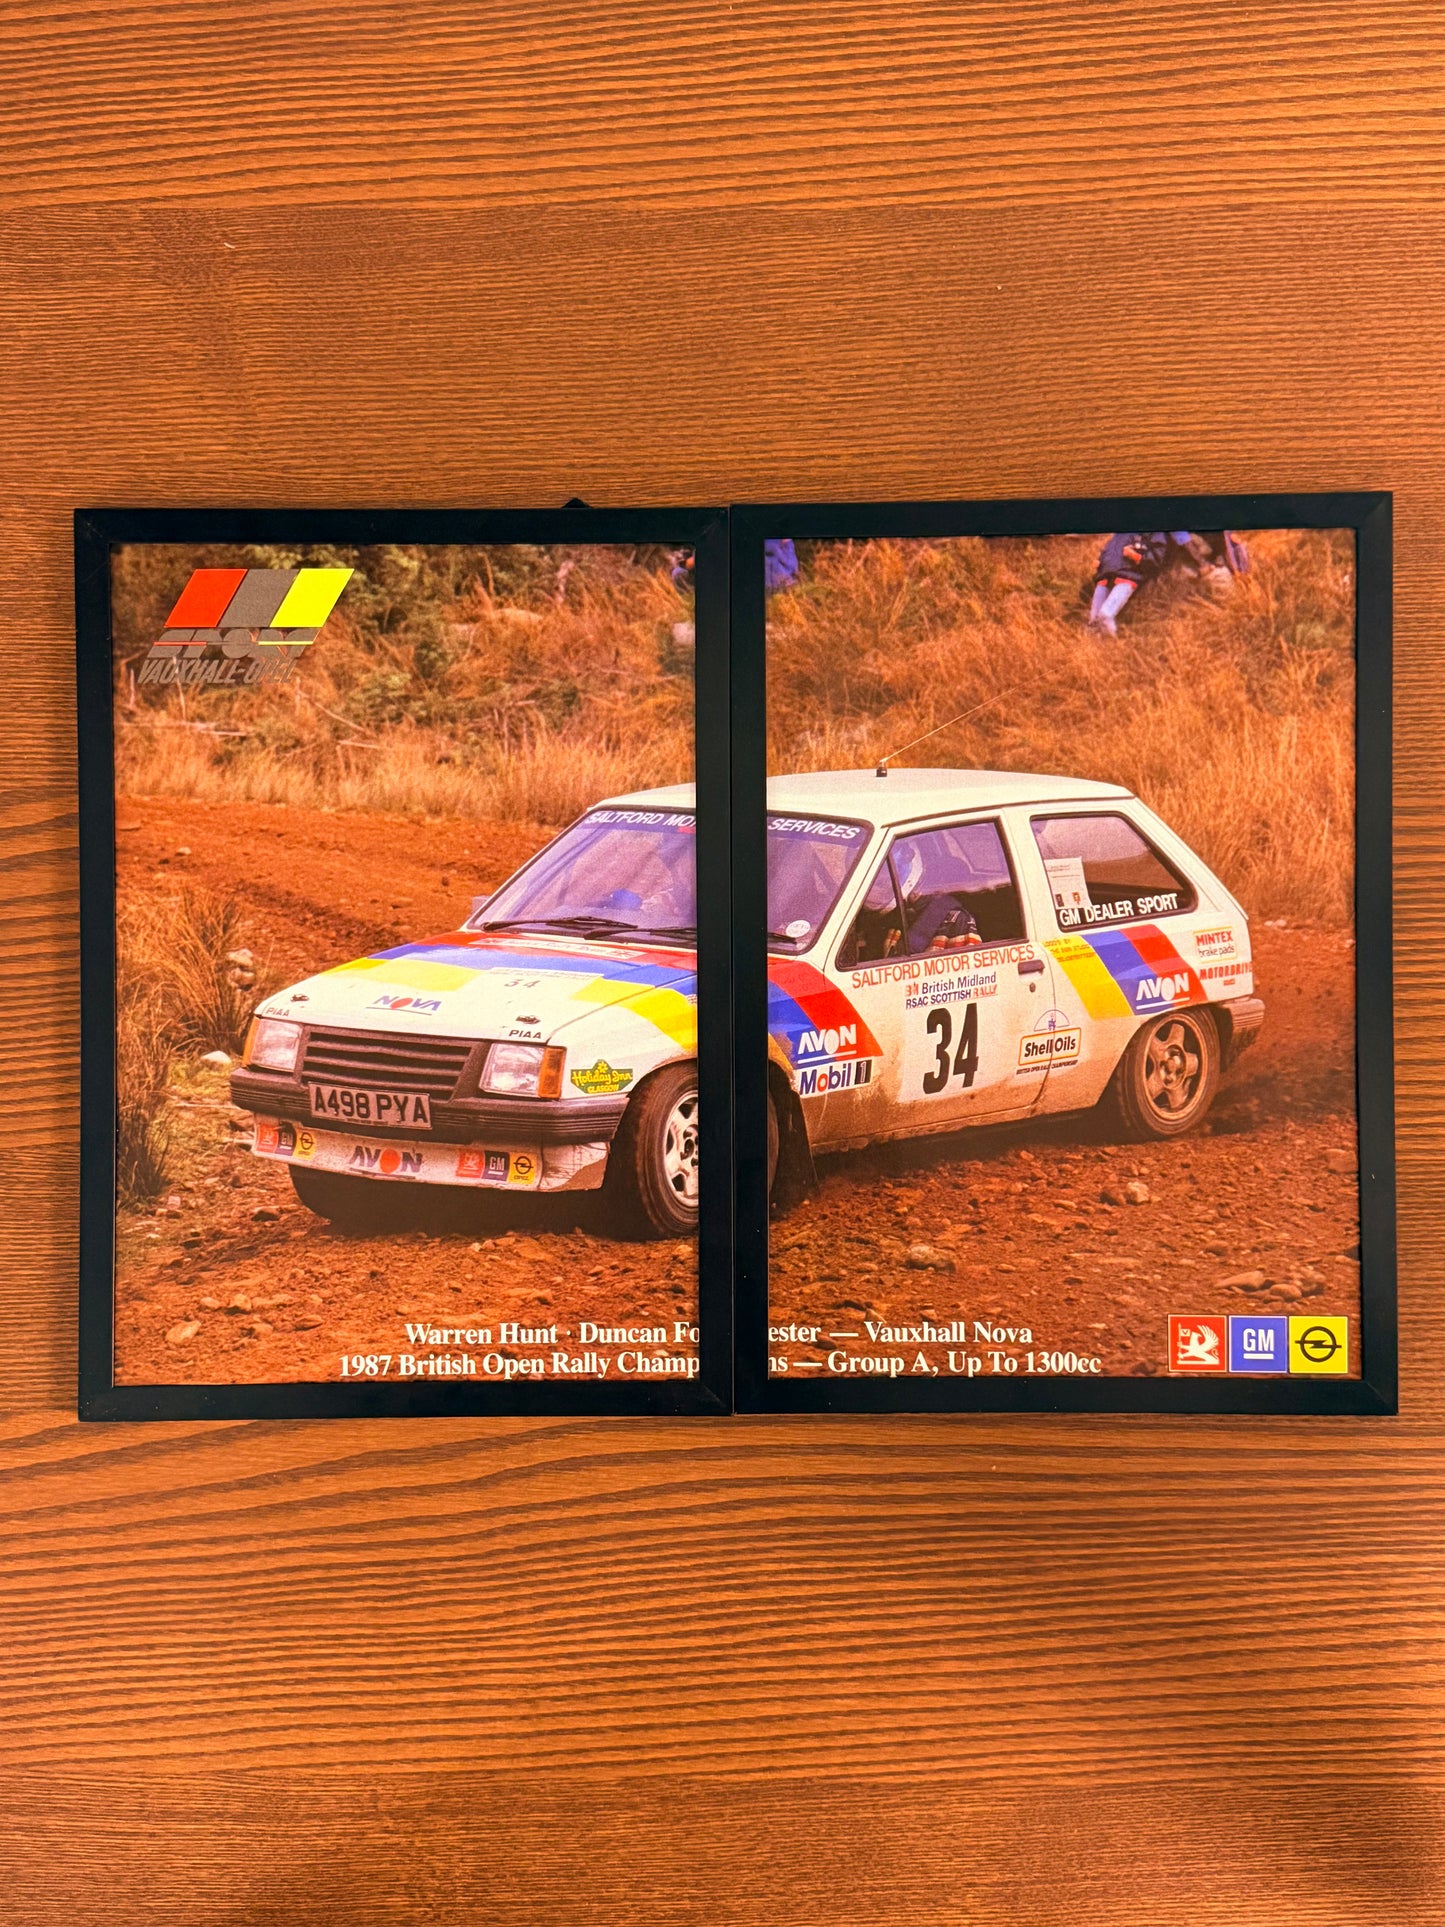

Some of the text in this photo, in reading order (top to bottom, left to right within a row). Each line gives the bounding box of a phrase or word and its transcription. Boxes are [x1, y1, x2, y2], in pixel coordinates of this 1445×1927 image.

[585, 811, 665, 826] SALTFORD
[767, 818, 861, 840] SERVICES
[1059, 893, 1179, 926] GM DEALER SPORT
[1195, 930, 1234, 946] MINTEX
[1198, 944, 1235, 958] brake pads
[851, 962, 921, 989] SALTFORD
[924, 952, 971, 974] MOTOR
[974, 944, 1035, 969] SERVICES
[503, 978, 541, 988] 34
[921, 979, 955, 995] British
[957, 971, 997, 989] Midland
[1136, 972, 1190, 1001] AVON
[372, 995, 443, 1011] NOVA
[906, 984, 998, 1010] RSAC SCOTTISH RALLY
[265, 1006, 291, 1018] PIAA
[508, 1029, 542, 1040] PIAA
[797, 1024, 857, 1055] AVON
[1024, 1035, 1077, 1058] Shell Oils
[922, 1002, 980, 1095] 34
[571, 1069, 633, 1087] Holiday Inn
[587, 1084, 620, 1094] GLASGOW
[799, 1063, 852, 1095] Mobil
[314, 1086, 429, 1124] A498 PYA
[350, 1144, 424, 1174] AVON
[489, 1156, 505, 1171] GM
[404, 1322, 493, 1345] Warren
[499, 1322, 559, 1344] Hunt
[579, 1321, 667, 1344] Duncan
[672, 1320, 700, 1343] Fo
[768, 1325, 822, 1343] ester
[863, 1320, 966, 1343] Vauxhall
[972, 1322, 1033, 1343] Nova
[1243, 1328, 1275, 1352] GM
[338, 1351, 700, 1380] 1987 British Open Rally Champ
[827, 1350, 905, 1378] Group
[910, 1351, 939, 1378] A,
[947, 1351, 983, 1378] Up
[987, 1351, 1018, 1373] To
[1024, 1350, 1102, 1374] 1300cc
